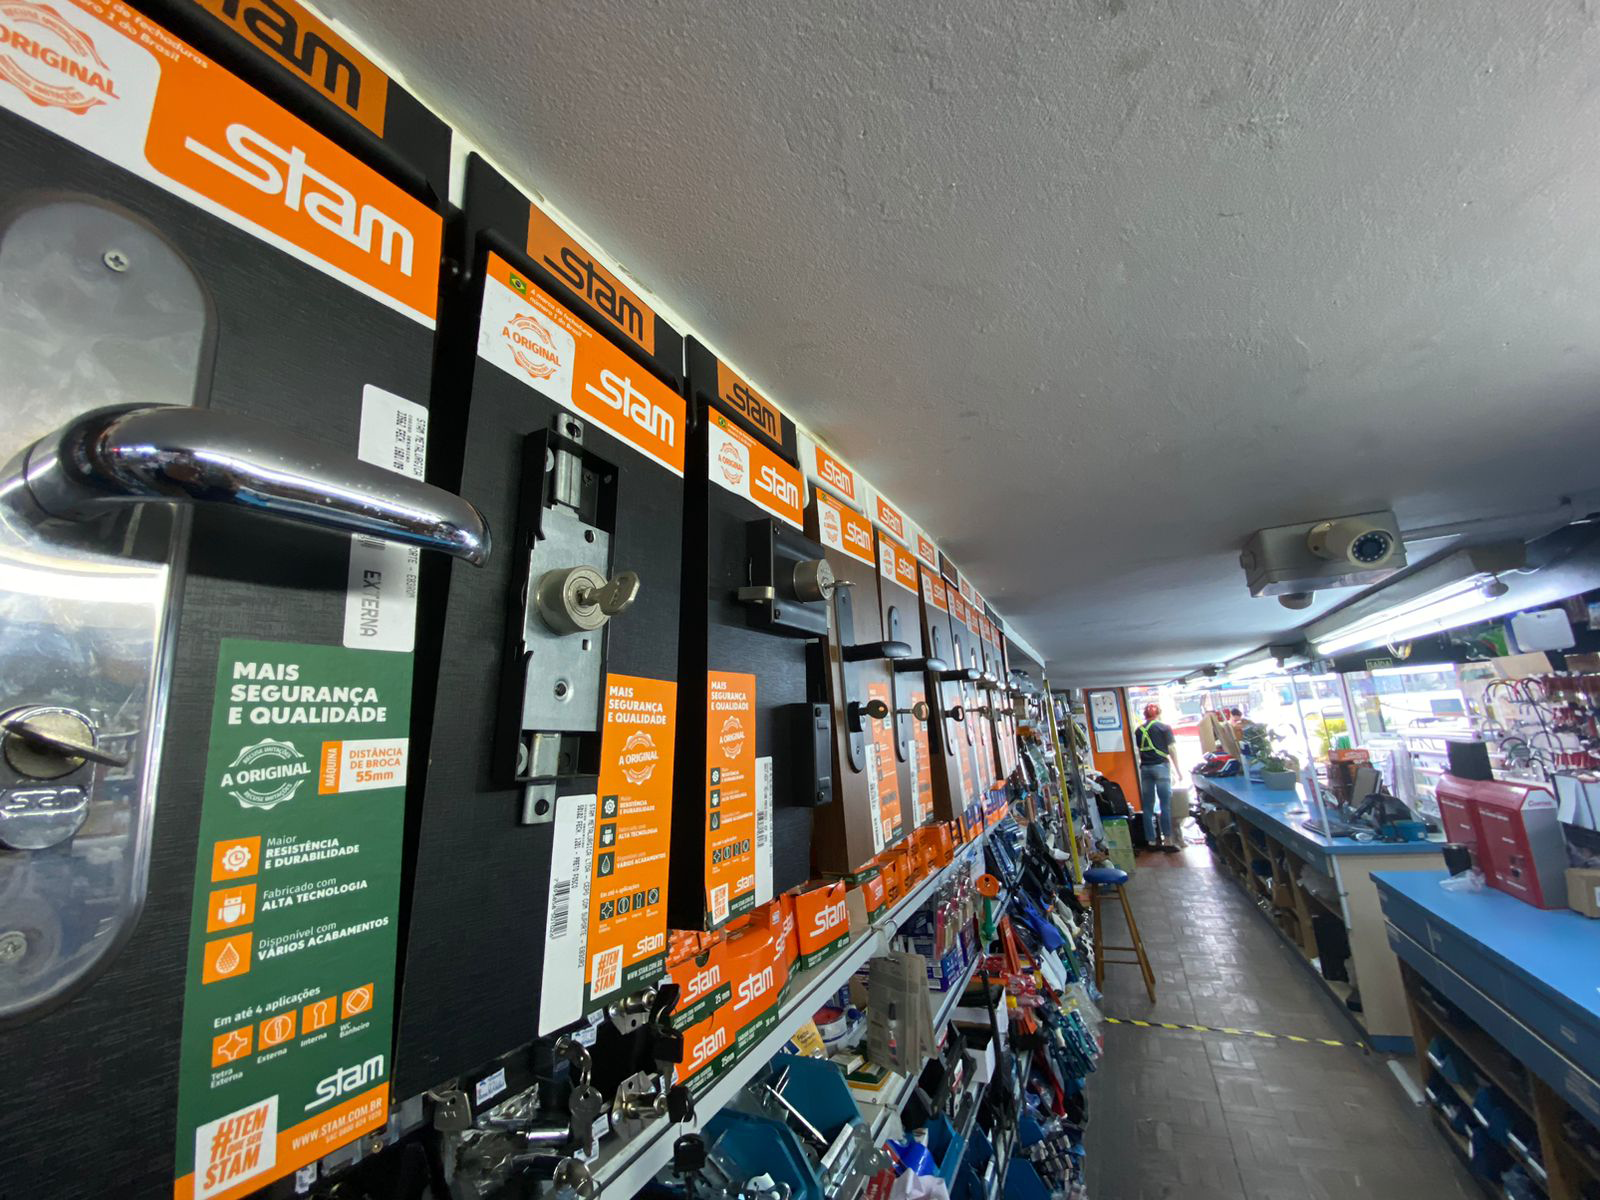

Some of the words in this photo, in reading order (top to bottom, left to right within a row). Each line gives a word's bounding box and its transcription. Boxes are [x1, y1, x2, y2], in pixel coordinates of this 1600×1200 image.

[113, 2, 131, 17] de
[135, 12, 209, 69] fechaduras
[119, 20, 138, 36] do
[140, 32, 180, 63] Brasil
[222, 0, 361, 112] am
[185, 123, 414, 277] stam
[544, 247, 644, 342] stam
[502, 326, 510, 338] A
[512, 331, 561, 368] ORIGINAL
[585, 368, 674, 448] stam
[726, 383, 776, 436] stam
[755, 465, 798, 510] stam
[822, 460, 851, 495] stam
[845, 522, 871, 551] stam
[360, 569, 382, 637] EXTERNA
[233, 662, 299, 681] MAIS
[230, 684, 378, 705] SEGURANÇA
[610, 686, 634, 698] MAIS
[711, 682, 726, 690] MAIS
[711, 692, 746, 701] SEGURANÇA
[228, 707, 242, 724] E
[250, 706, 387, 724] QUALIDADE
[608, 699, 663, 713] SEGURANÇA
[608, 713, 612, 722] E
[616, 712, 666, 724] QUALIDADE
[716, 702, 749, 710] QUALIDADE
[350, 747, 403, 759] DISTÂNCIA
[350, 760, 364, 769] DE
[366, 758, 400, 768] BROCA
[618, 756, 624, 766] A
[626, 752, 659, 764] ORIGINAL
[221, 773, 234, 787] A
[236, 762, 311, 784] ORIGINAL
[324, 748, 338, 786] MÁQUINA
[356, 769, 394, 782] 55mm
[266, 838, 339, 858] RESISTÊNCIA
[267, 835, 297, 847] Maior
[264, 860, 272, 869] E
[274, 844, 360, 868] DURABILIDADE
[262, 894, 294, 912] ALTA
[296, 880, 368, 904] TECNOLOGIA
[263, 882, 314, 900] Fabricado
[316, 877, 336, 887] com
[734, 874, 754, 894] stam
[810, 900, 846, 938] stam
[258, 940, 305, 961] VÁRIOS
[307, 916, 389, 947] ACABAMENTOS
[259, 926, 314, 950] Disponível
[316, 922, 336, 934] com
[632, 932, 664, 958] stam
[594, 972, 616, 993] STAM
[684, 965, 720, 1004] stam
[734, 966, 774, 1012] stam
[213, 1016, 232, 1028] Em
[235, 1007, 253, 1022] até
[256, 1004, 262, 1014] 4
[265, 986, 320, 1012] aplicações
[300, 1032, 328, 1048] Interna
[688, 1026, 726, 1070] stam
[257, 1048, 288, 1064] Externa
[210, 1072, 243, 1088] Externa
[211, 1068, 233, 1081] Tetra
[304, 1054, 384, 1112] stam
[210, 1104, 269, 1163] #TEM
[292, 1097, 382, 1150] WWW.STAM.COM.BR
[204, 1145, 260, 1190] STAM
